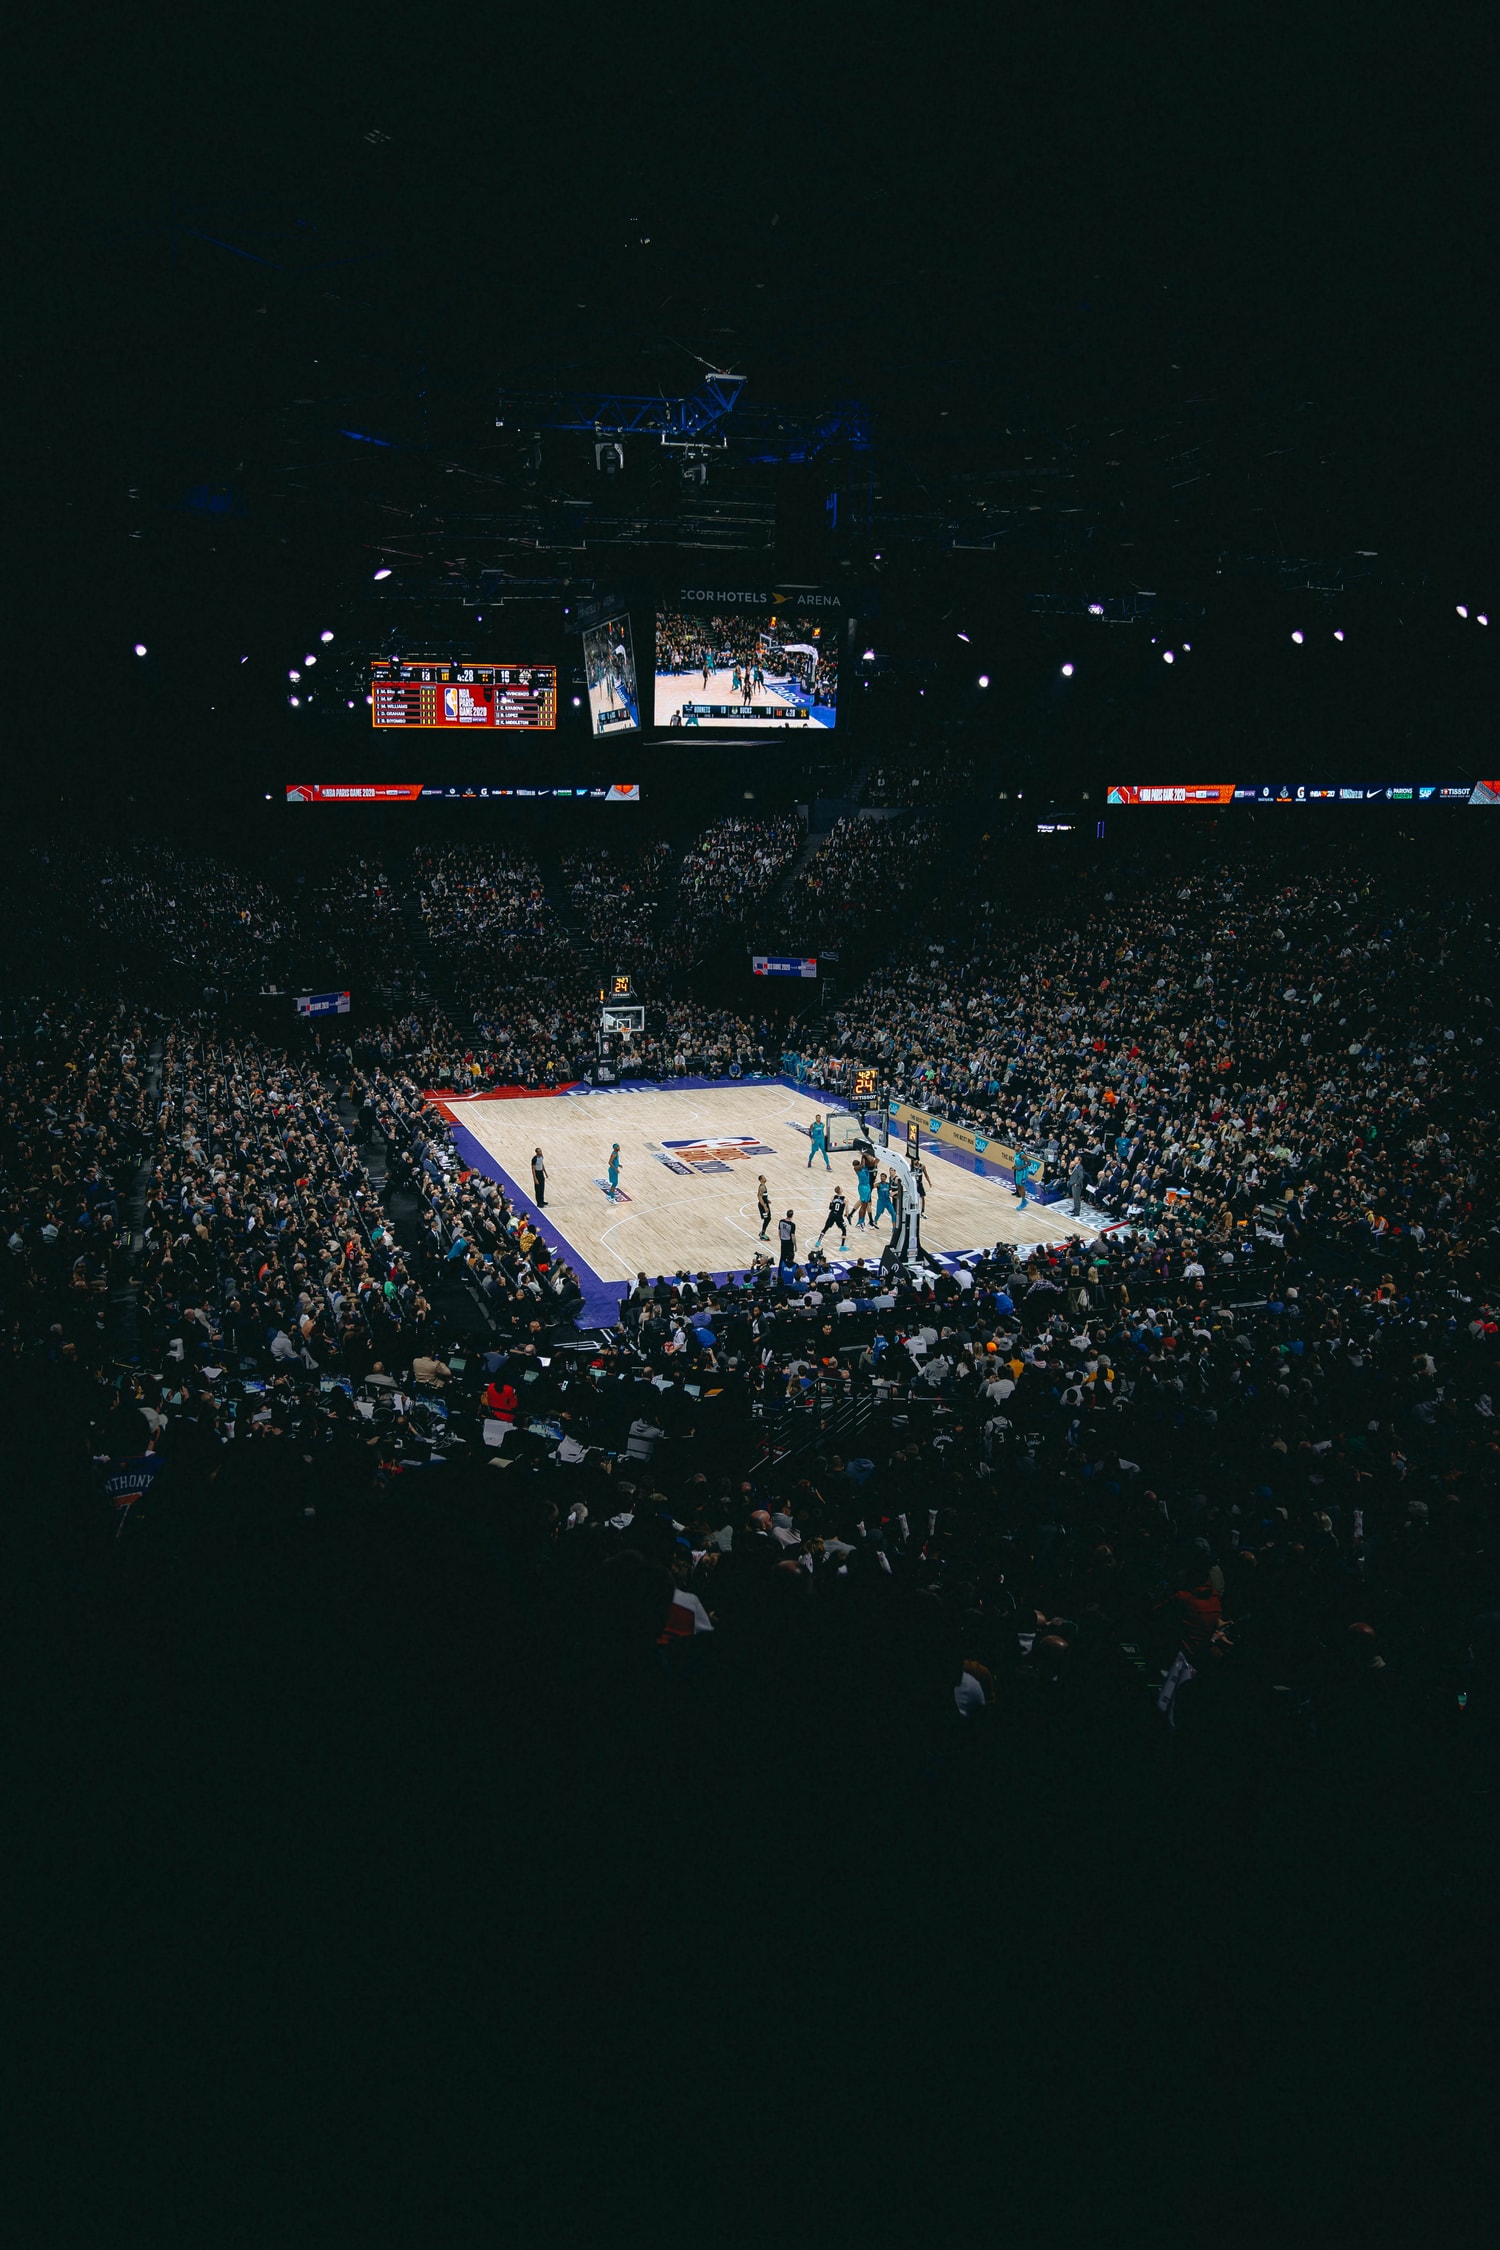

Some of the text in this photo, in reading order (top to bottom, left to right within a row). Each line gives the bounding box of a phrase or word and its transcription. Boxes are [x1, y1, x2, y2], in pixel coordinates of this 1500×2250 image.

[797, 596, 841, 606] ARENA
[457, 670, 474, 682] 4:28
[459, 688, 469, 698] NBA
[459, 698, 474, 707] PARIS
[459, 706, 487, 717] GAME 2020
[785, 709, 796, 717] 4:28
[336, 789, 349, 797] PARIS
[350, 789, 362, 797] GAME
[363, 789, 375, 797] 2020
[1174, 788, 1186, 801] 2020
[614, 983, 628, 993] 24
[858, 1070, 876, 1079] 4:27
[567, 1086, 660, 1097] PARIS
[855, 1080, 873, 1094] 24
[834, 1203, 840, 1211] 0
